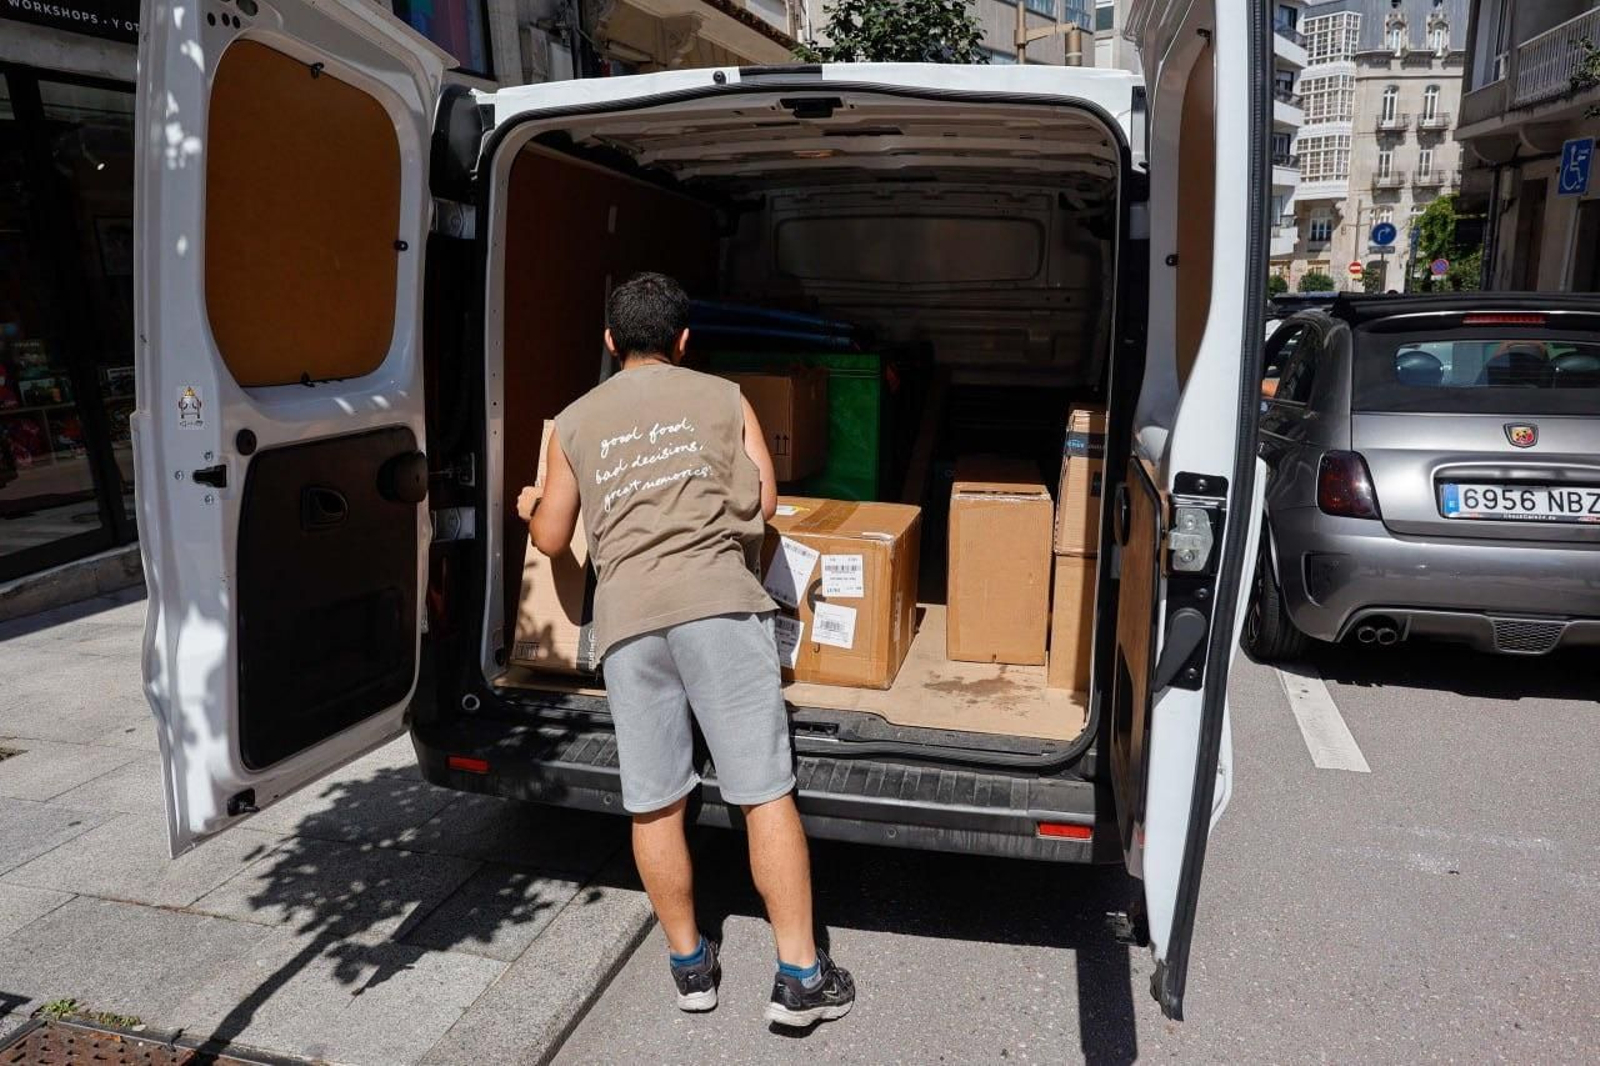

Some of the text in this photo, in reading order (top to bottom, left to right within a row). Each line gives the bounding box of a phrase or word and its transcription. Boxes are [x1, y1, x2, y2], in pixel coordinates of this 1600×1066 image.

[9, 0, 98, 24] WORKSHOPS
[113, 18, 120, 28] Y
[600, 417, 695, 459] good food,
[596, 441, 704, 484] bad decisions,
[604, 479, 641, 511] great
[1464, 488, 1600, 514] 6956 NBZ
